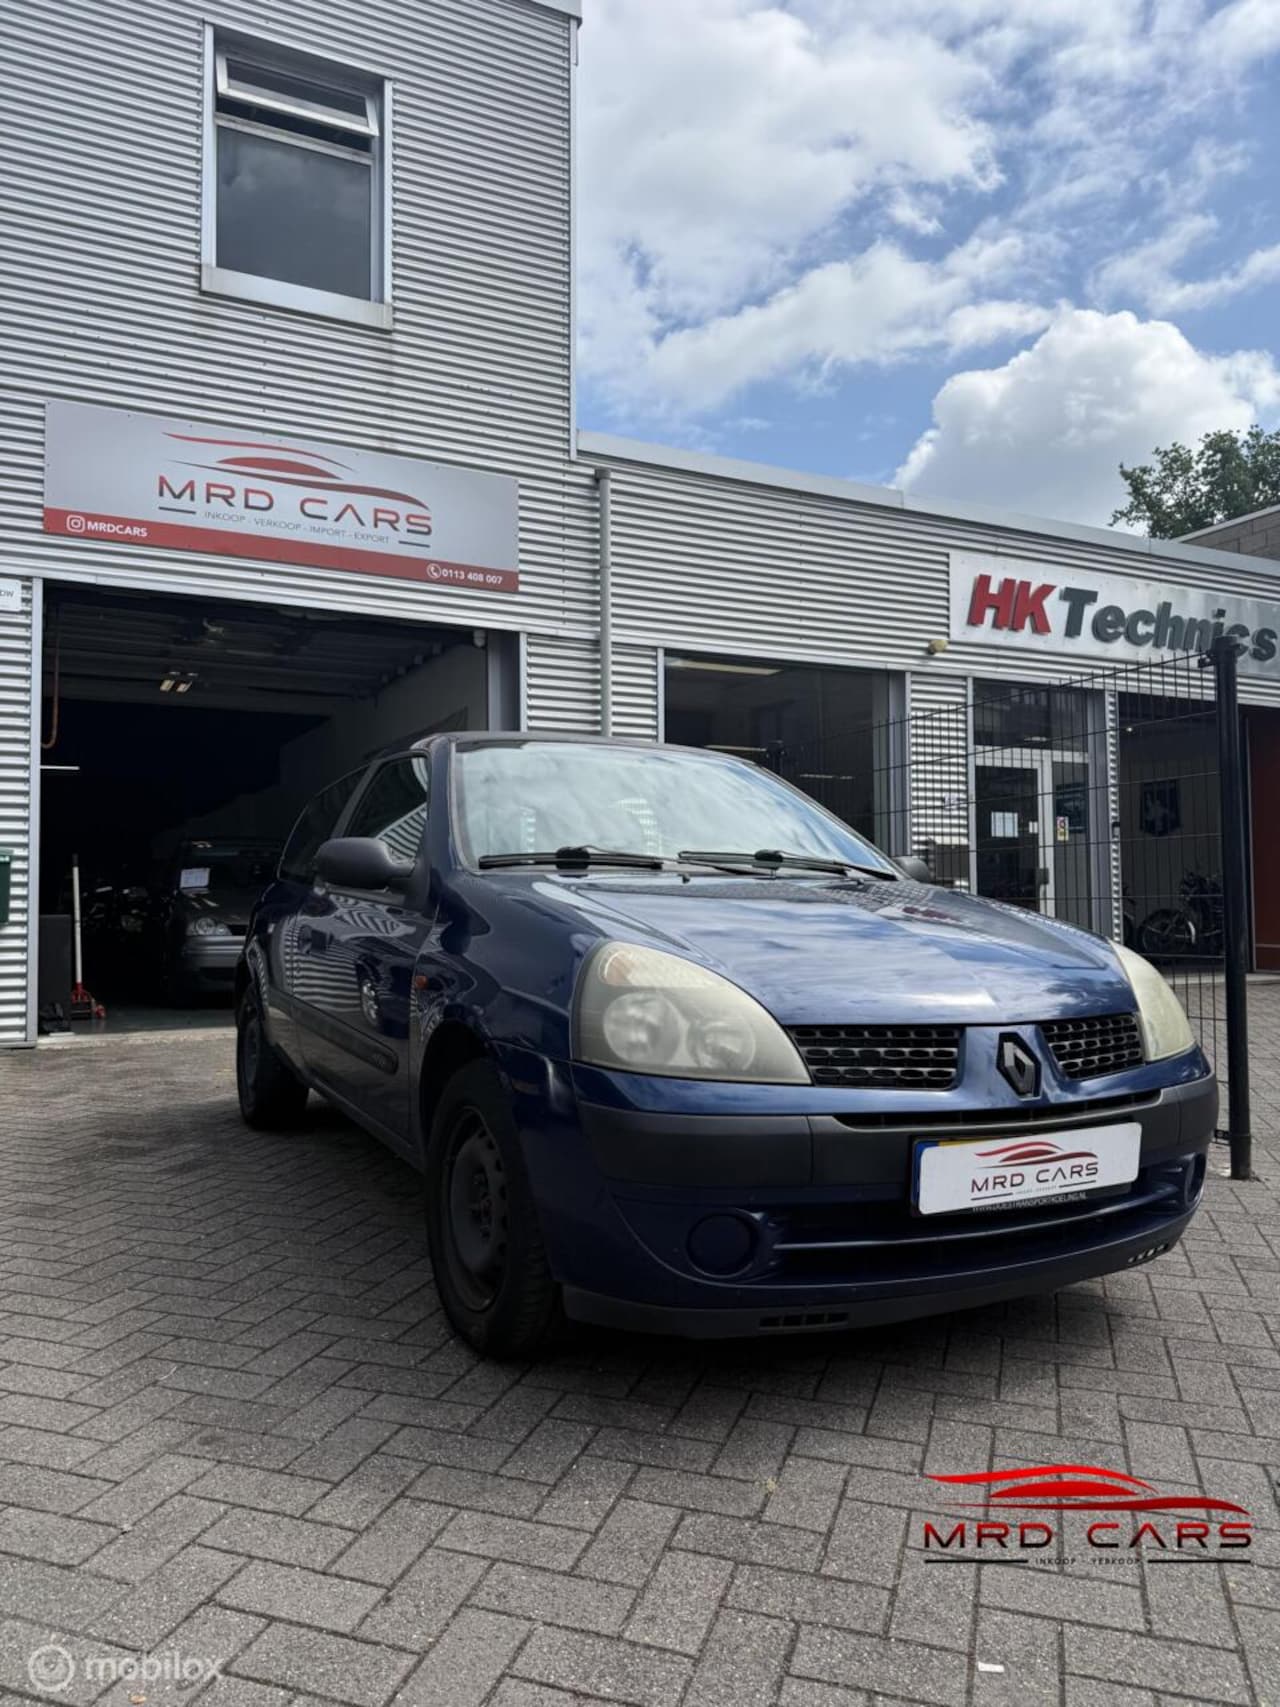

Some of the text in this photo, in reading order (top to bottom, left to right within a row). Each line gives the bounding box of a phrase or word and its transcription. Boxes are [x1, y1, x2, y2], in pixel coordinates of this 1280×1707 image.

[158, 475, 432, 536] MRD CARS
[87, 521, 148, 537] MRDCARS
[204, 511, 389, 544] INKOOP VERKOOP IMPORT EXPORT
[442, 568, 465, 580] 0113
[486, 574, 503, 584] 007
[971, 1173, 1025, 1193] MRD
[1035, 1162, 1099, 1183] CARS
